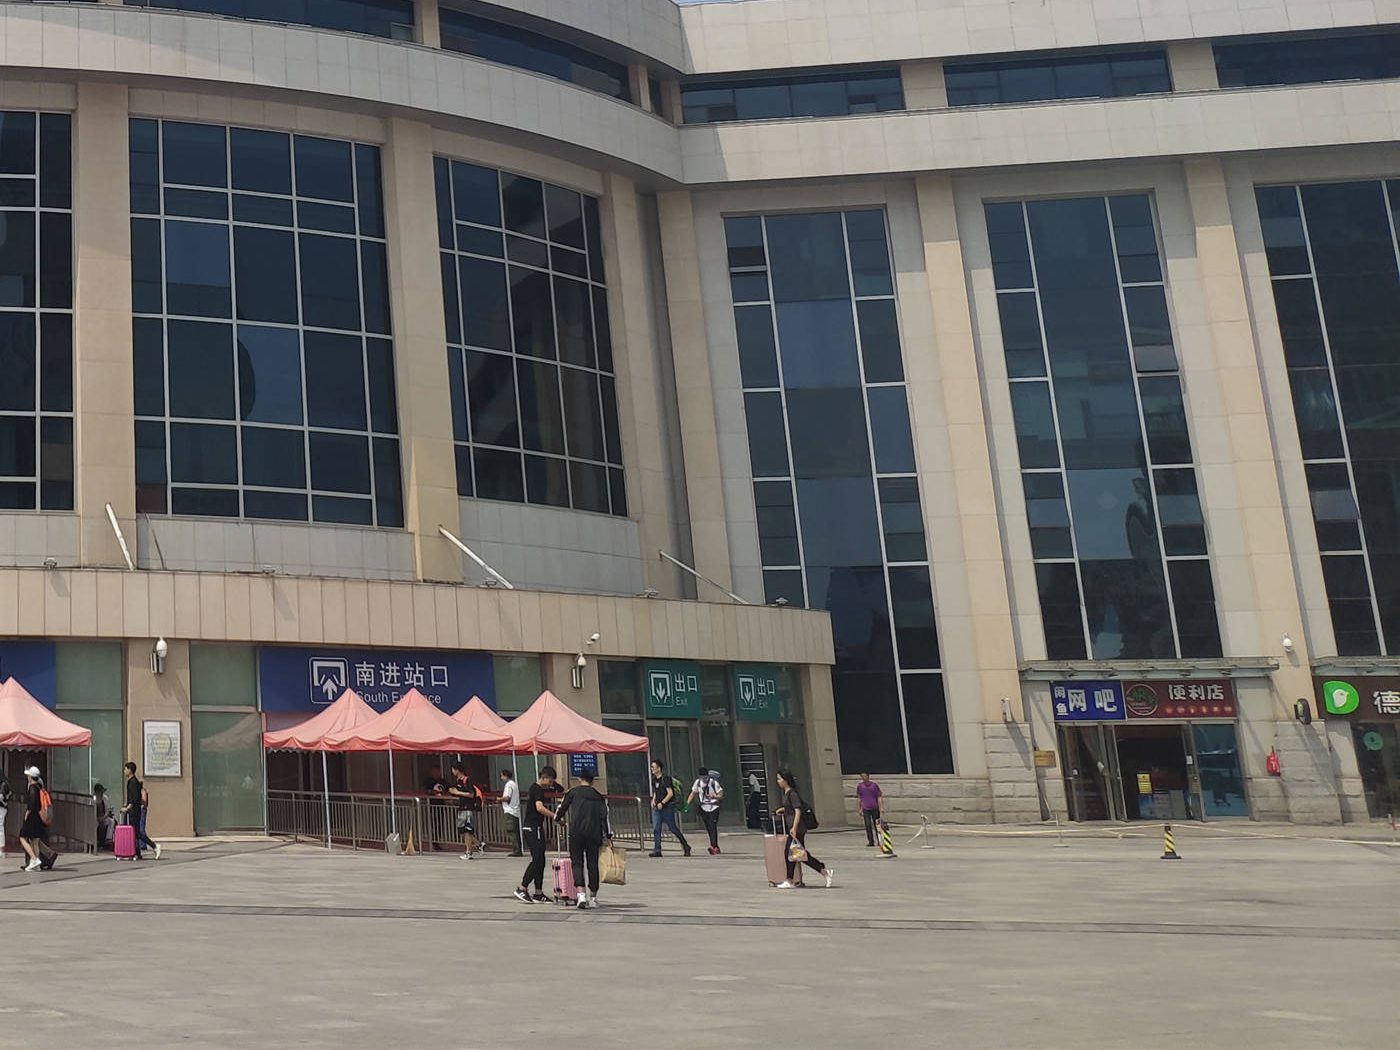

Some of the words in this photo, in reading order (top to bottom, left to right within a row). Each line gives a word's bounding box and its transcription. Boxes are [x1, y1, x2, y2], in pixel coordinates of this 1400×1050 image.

[354, 661, 449, 688] 南进站口
[674, 672, 698, 693] 出口
[757, 677, 775, 696] 出口
[1168, 684, 1225, 700] 便利店
[1067, 689, 1118, 712] 网吧
